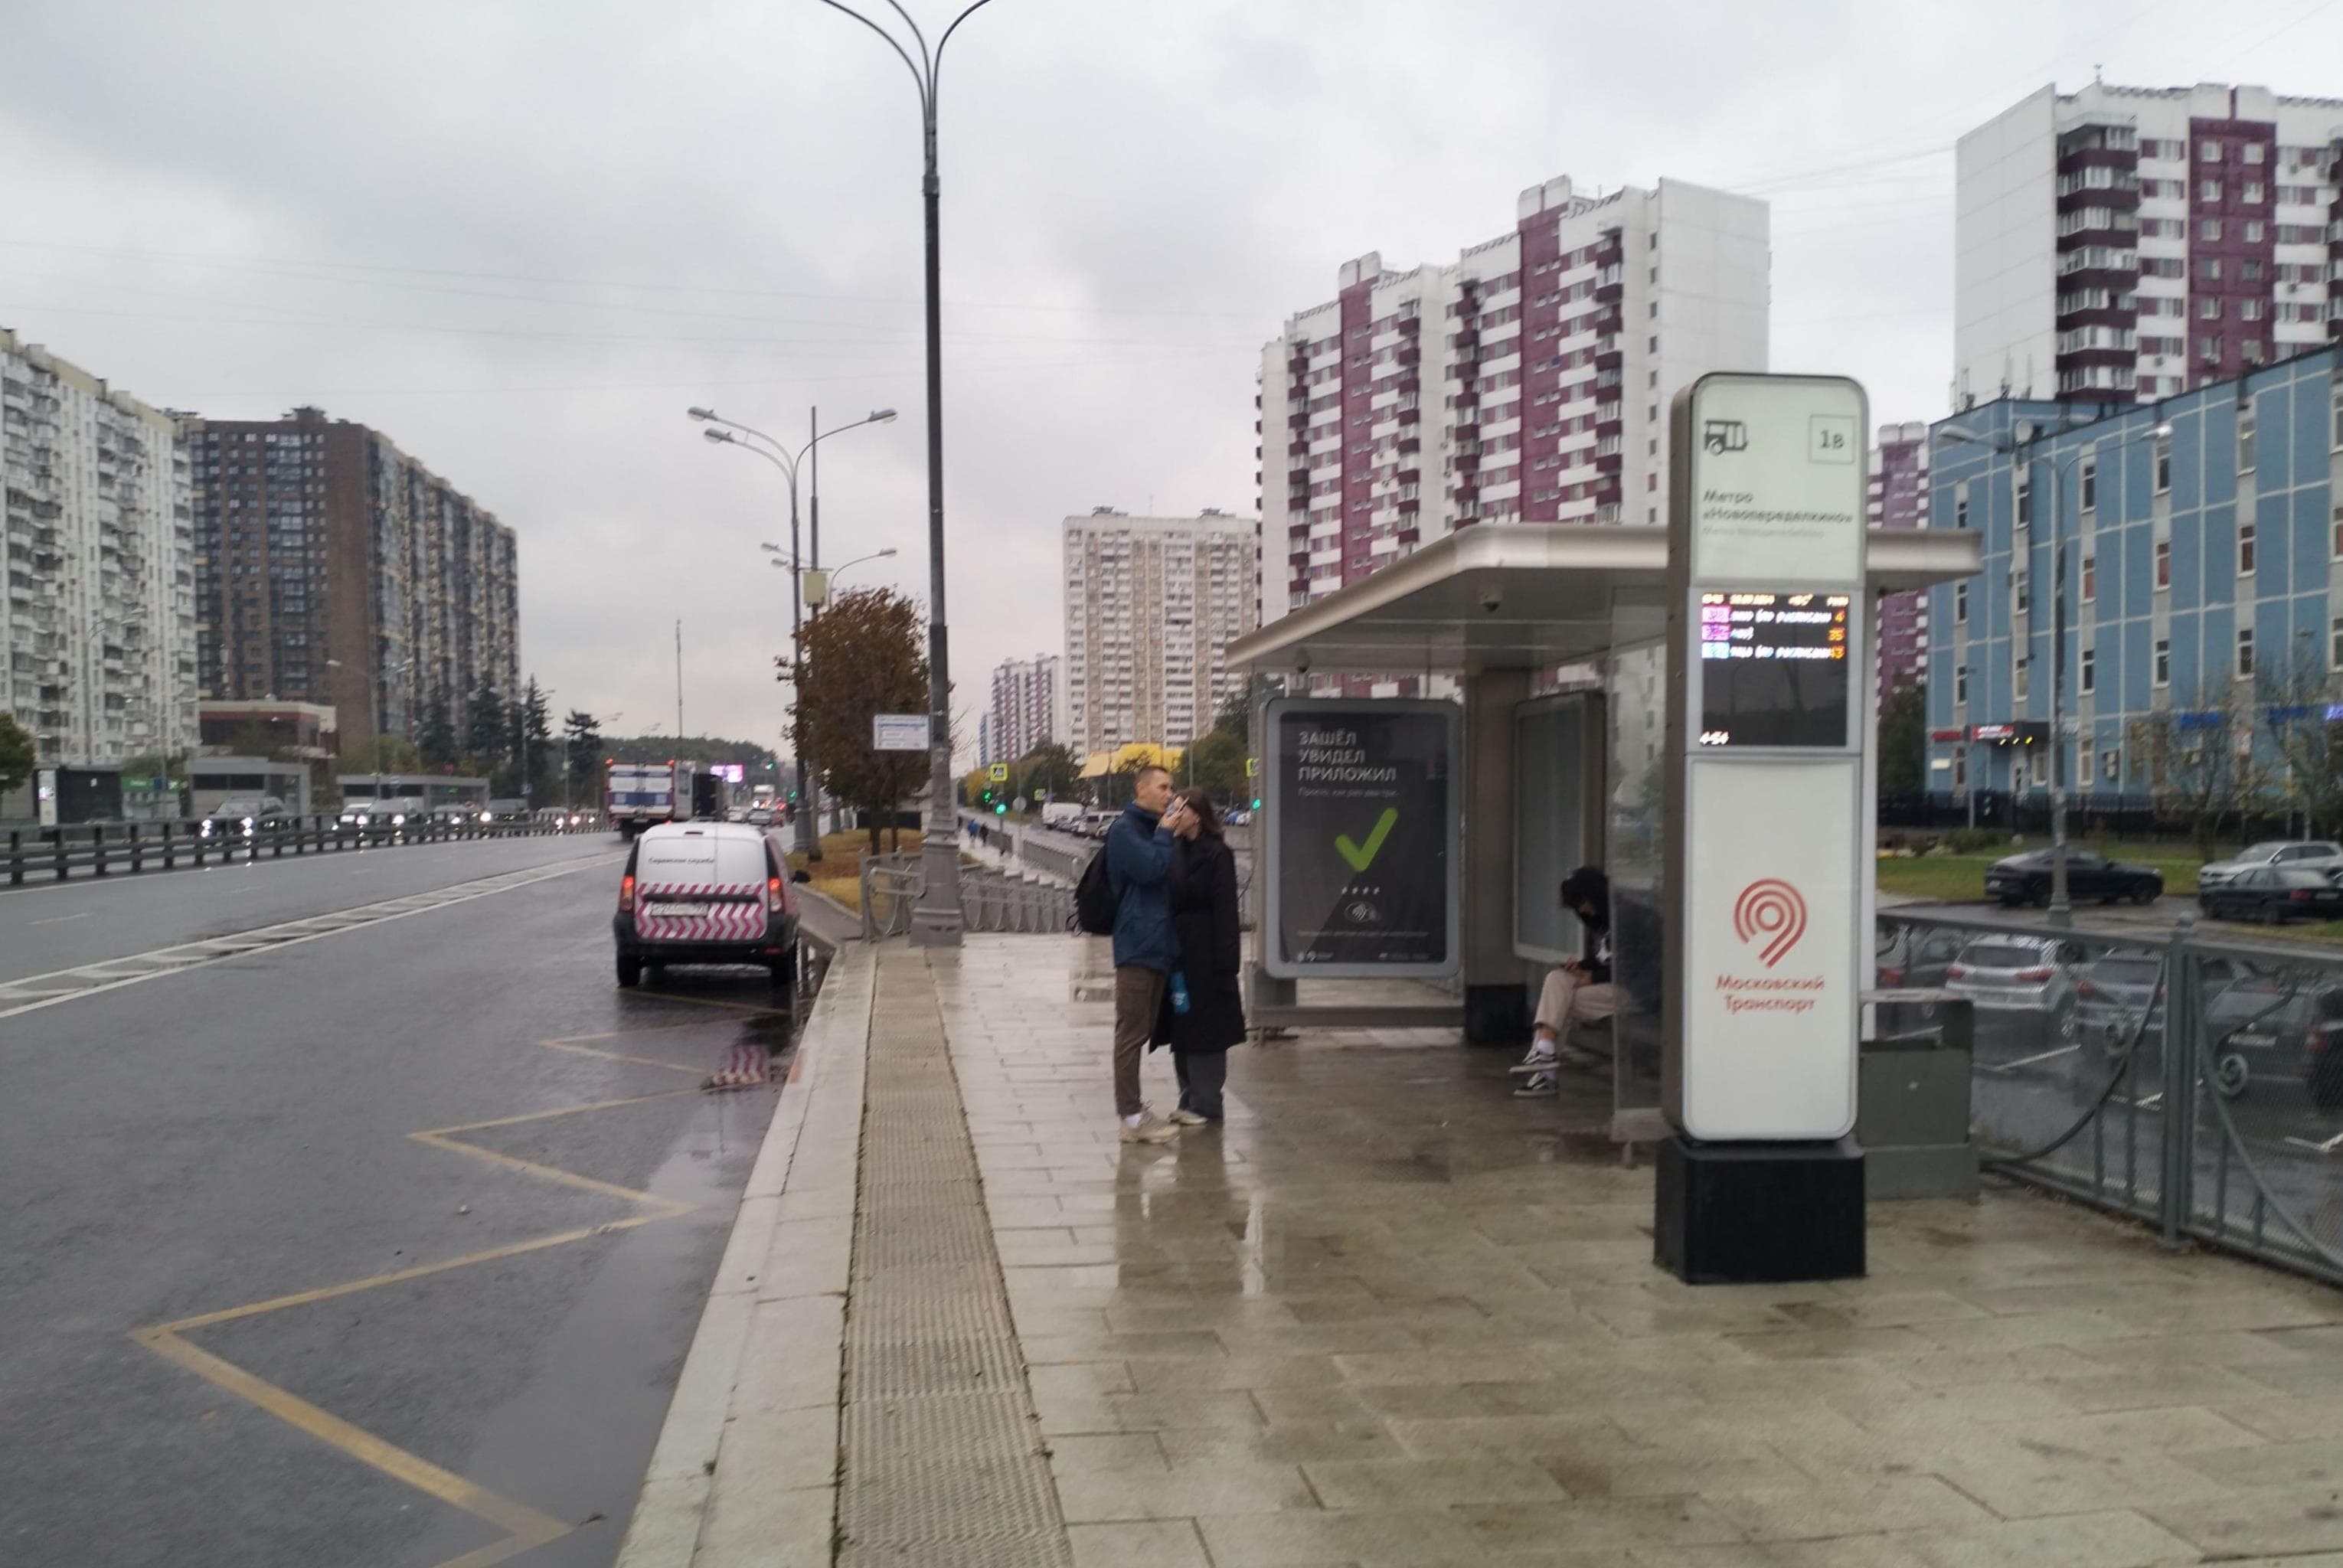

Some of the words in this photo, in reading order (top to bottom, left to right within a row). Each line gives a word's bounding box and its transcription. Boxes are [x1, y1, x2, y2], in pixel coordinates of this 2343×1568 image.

[1299, 750, 1365, 765] УВИДЕЛ
[1299, 767, 1397, 781] ПРИЛОЖИЛ
[1717, 974, 1824, 991] Московский
[1726, 994, 1814, 1014] Транспорт
